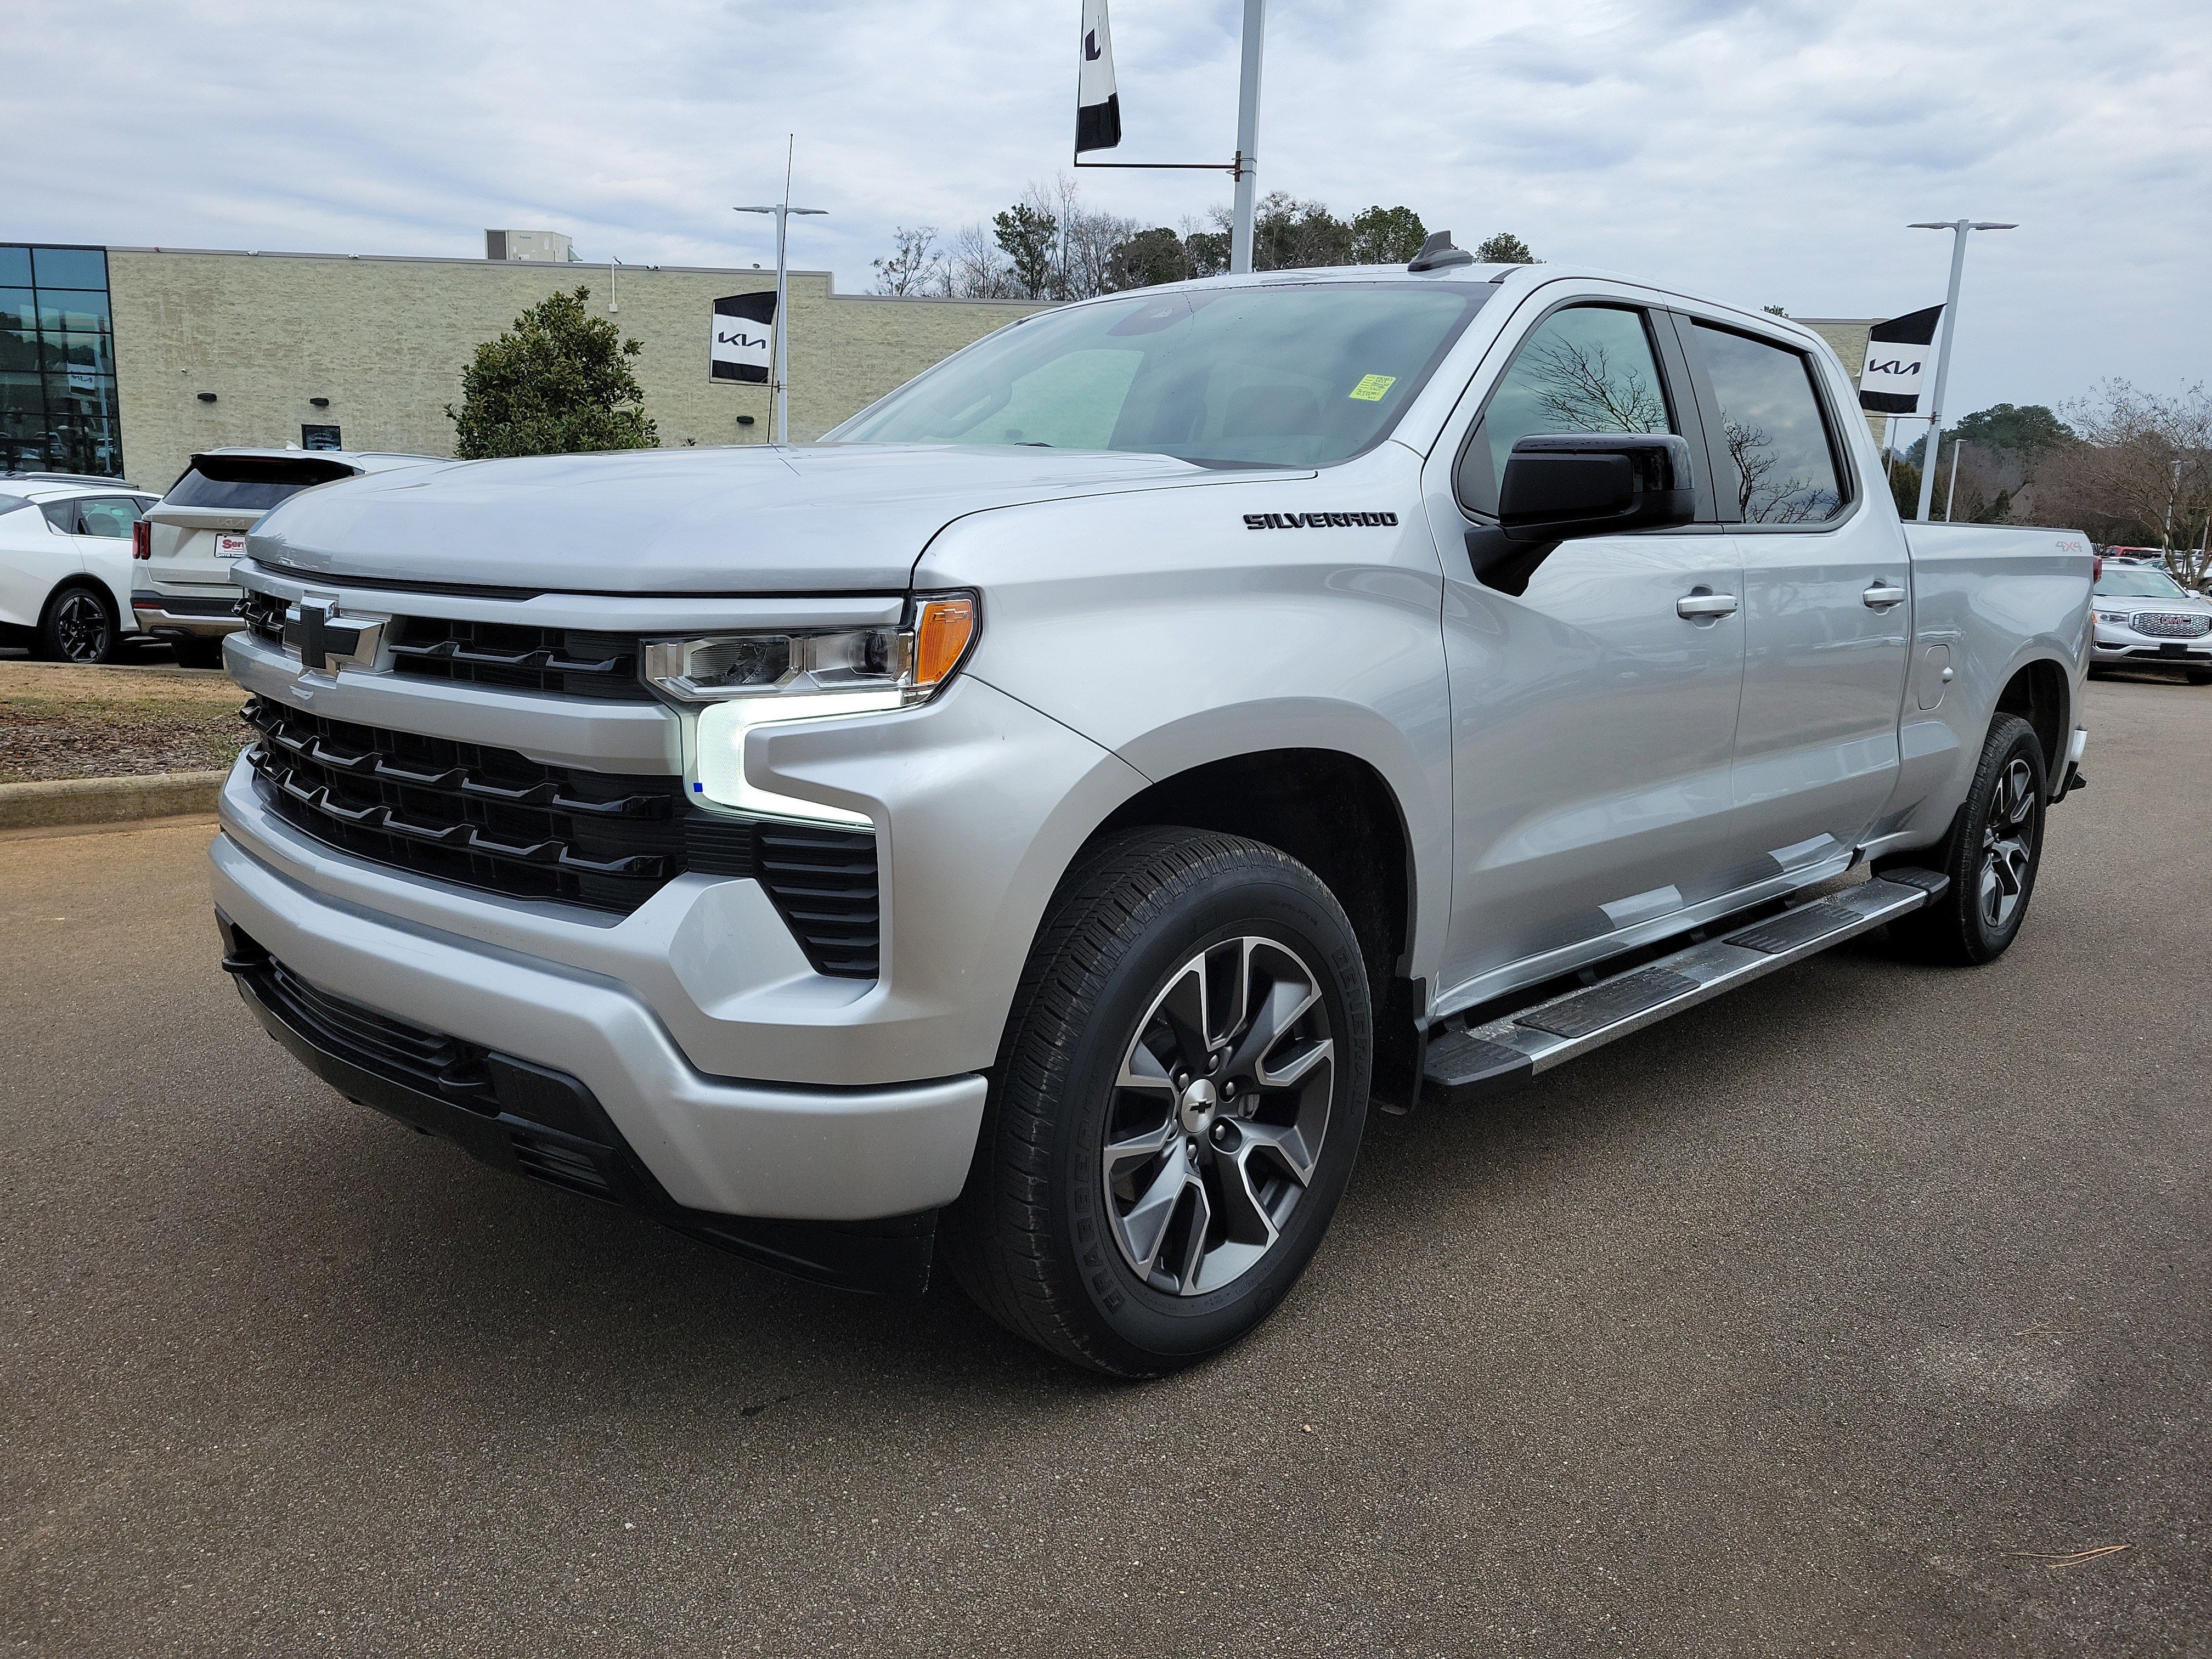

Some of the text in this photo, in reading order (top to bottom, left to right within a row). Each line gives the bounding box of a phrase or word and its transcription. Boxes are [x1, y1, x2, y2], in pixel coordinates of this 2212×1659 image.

[718, 331, 766, 350] KIA
[1869, 358, 1921, 376] KIA
[1243, 512, 1400, 529] SILVERADO
[1331, 946, 1367, 1115] GENERAL
[1074, 1119, 1126, 1315] GRABBER
